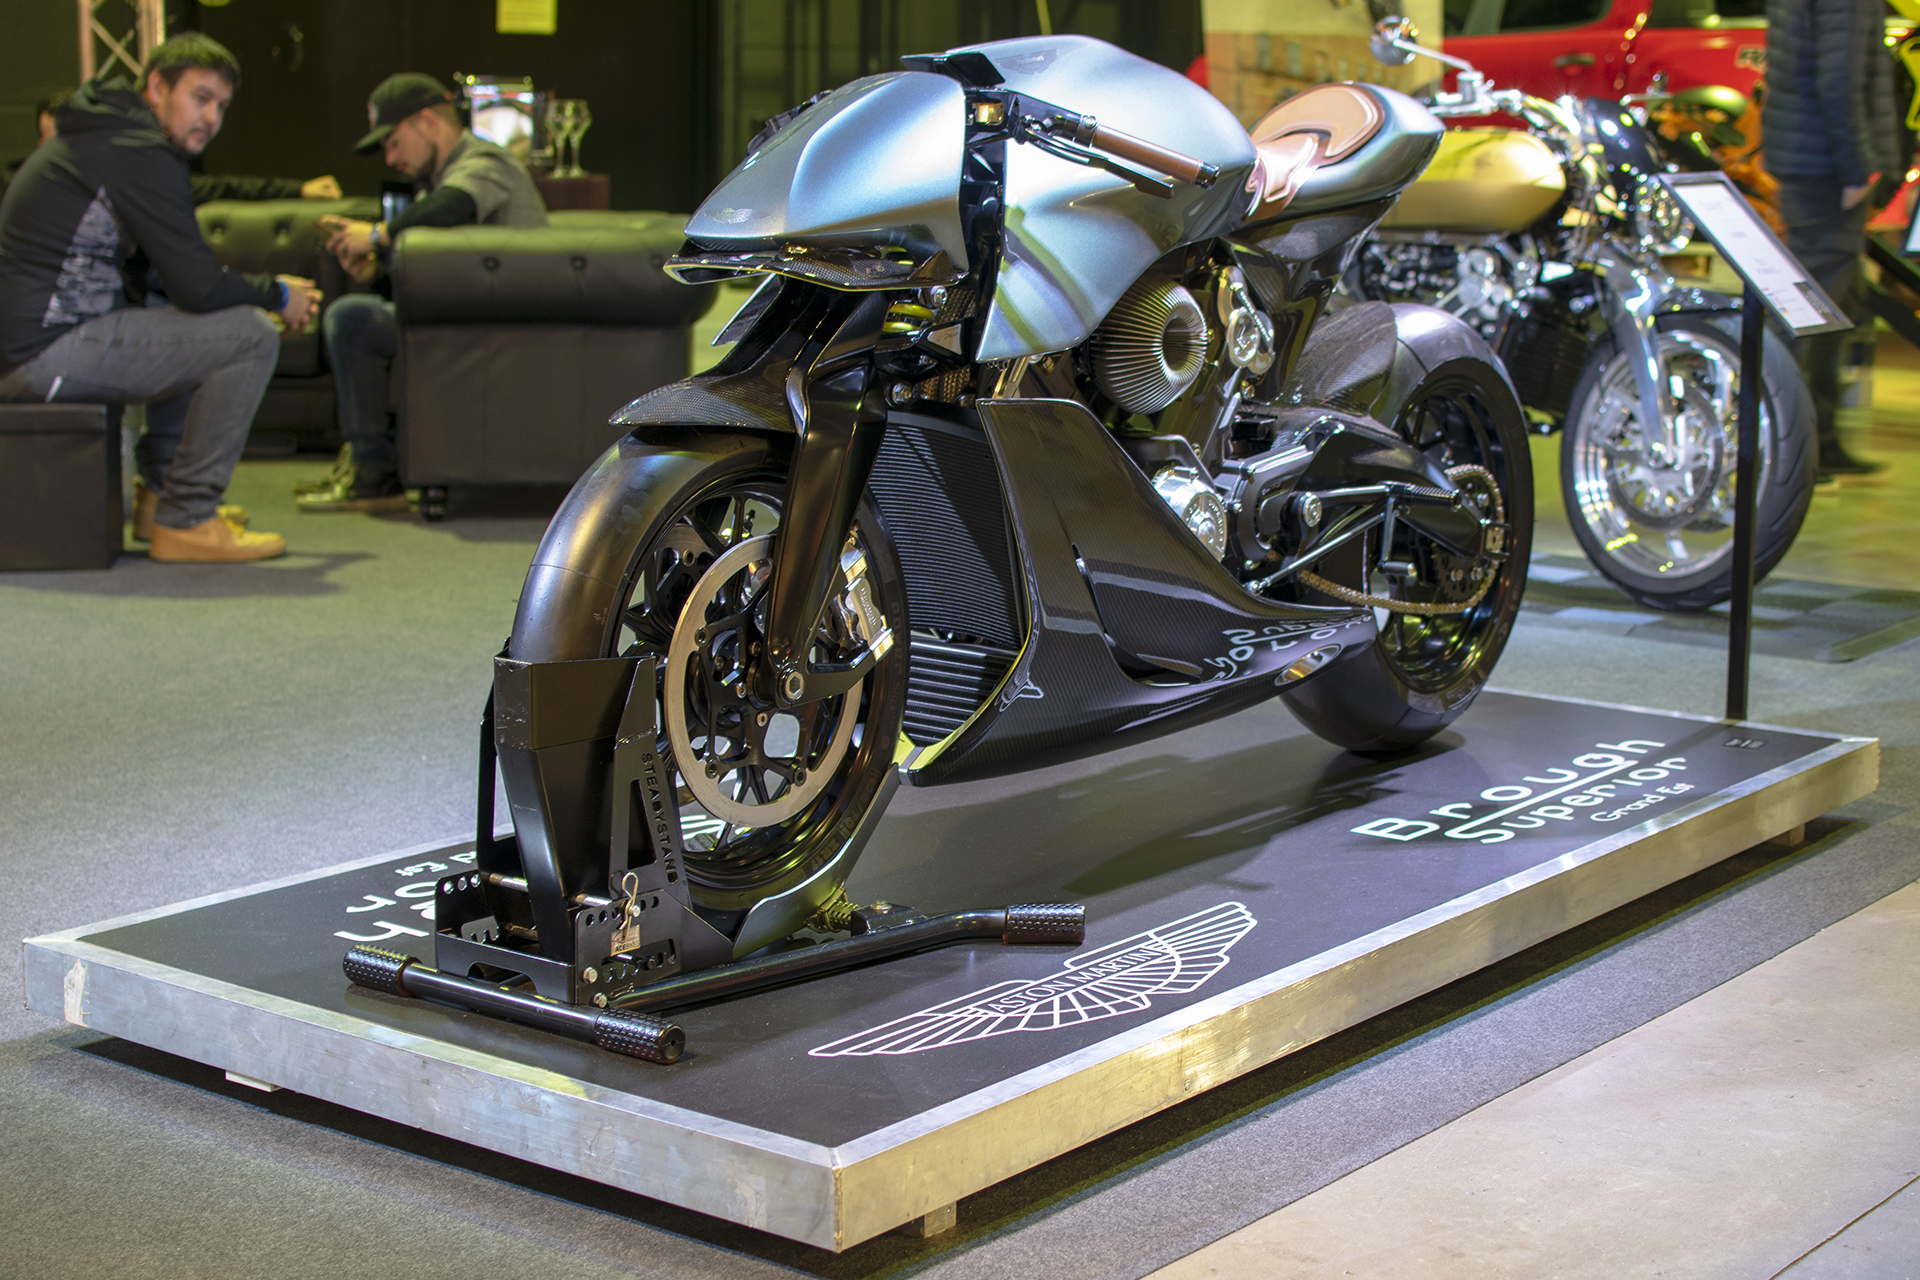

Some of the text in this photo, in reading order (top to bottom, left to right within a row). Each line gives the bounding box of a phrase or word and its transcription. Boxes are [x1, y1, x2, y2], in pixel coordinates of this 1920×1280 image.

[641, 752, 679, 885] STEADYSTAND
[1350, 738, 1667, 842] Brough
[1444, 757, 1687, 842] Superior
[1590, 782, 1695, 823] Grand Est
[988, 947, 1163, 1013] ASTON MARTIN
